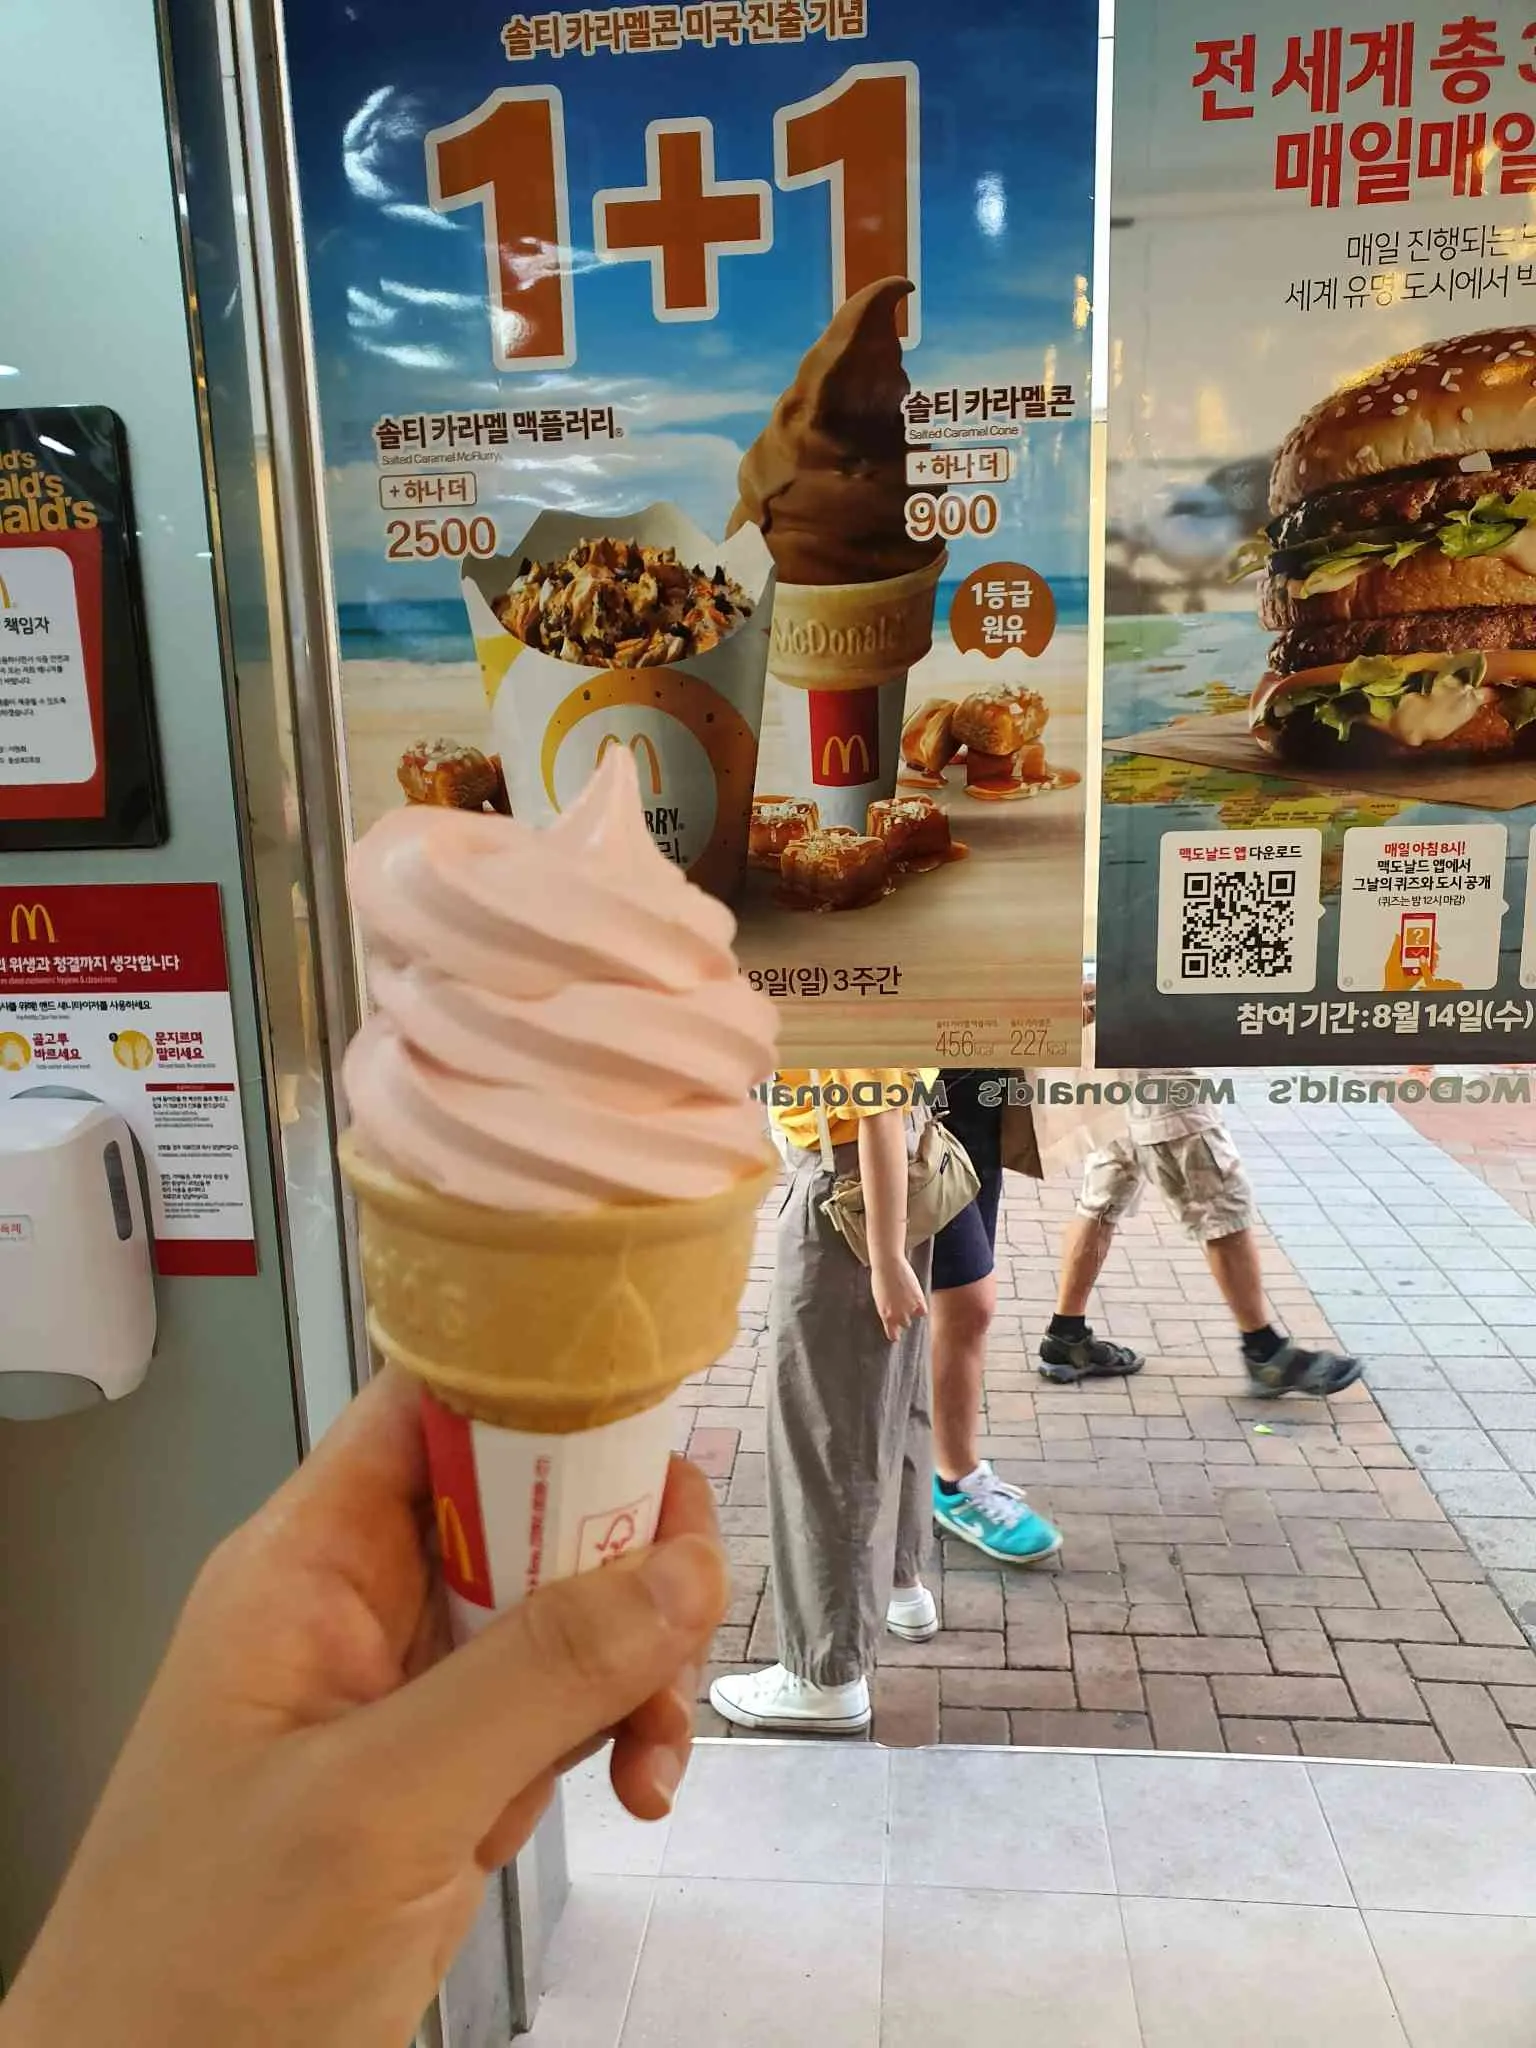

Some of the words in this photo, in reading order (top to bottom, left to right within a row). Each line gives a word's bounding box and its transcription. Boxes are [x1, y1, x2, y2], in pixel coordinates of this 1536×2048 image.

[504, 15, 561, 57] 솔티
[566, 10, 681, 54] 카라멜콘
[686, 5, 742, 44] 미국
[748, 1, 808, 40] 진출
[809, 0, 866, 37] 기념
[1192, 34, 1256, 121] 전
[1271, 22, 1415, 113] 세계
[1430, 16, 1505, 105] 총
[1346, 230, 1400, 266] 매일
[1406, 224, 1517, 262] 진행되는
[1284, 277, 1338, 312] 세계
[1342, 271, 1396, 308] 유명
[1399, 265, 1510, 302] 도시에서
[905, 389, 957, 423] 솔티
[965, 385, 1075, 420] 카라멜콘
[376, 416, 426, 450] 솔티
[431, 412, 509, 446] 카라멜
[909, 428, 942, 440] Salted
[943, 426, 989, 438] Caramel
[989, 425, 1020, 436] Cone
[382, 453, 412, 466] Salted
[414, 451, 456, 465] Caramel
[979, 452, 998, 477] 더
[448, 477, 467, 502] 더
[0, 496, 98, 533] ald's
[909, 495, 997, 537] 900
[386, 517, 497, 558] 2500
[970, 580, 1033, 610] 1등급
[981, 614, 1027, 644] 원유
[1179, 847, 1232, 862] 맥도날드
[1234, 846, 1248, 861] 앱
[1249, 845, 1302, 861] 다운로드
[1384, 842, 1410, 858] 매일
[1412, 841, 1438, 857] 아침
[1440, 841, 1466, 856] 8시!
[1377, 859, 1429, 875] 맥도날드
[1432, 858, 1471, 873] 앱에서
[1352, 876, 1393, 893] 그날의
[1394, 876, 1434, 892] 퀴즈와
[1437, 875, 1462, 891] 도시
[1464, 874, 1491, 891] 공개
[1411, 896, 1421, 907] 밤
[9, 956, 50, 973] 위생과
[110, 954, 180, 972] 생각합니다
[738, 965, 828, 997] 8일(일)
[832, 965, 902, 996] 3주간
[1236, 1002, 1296, 1036] 참여
[1425, 999, 1534, 1034] 14일(수)
